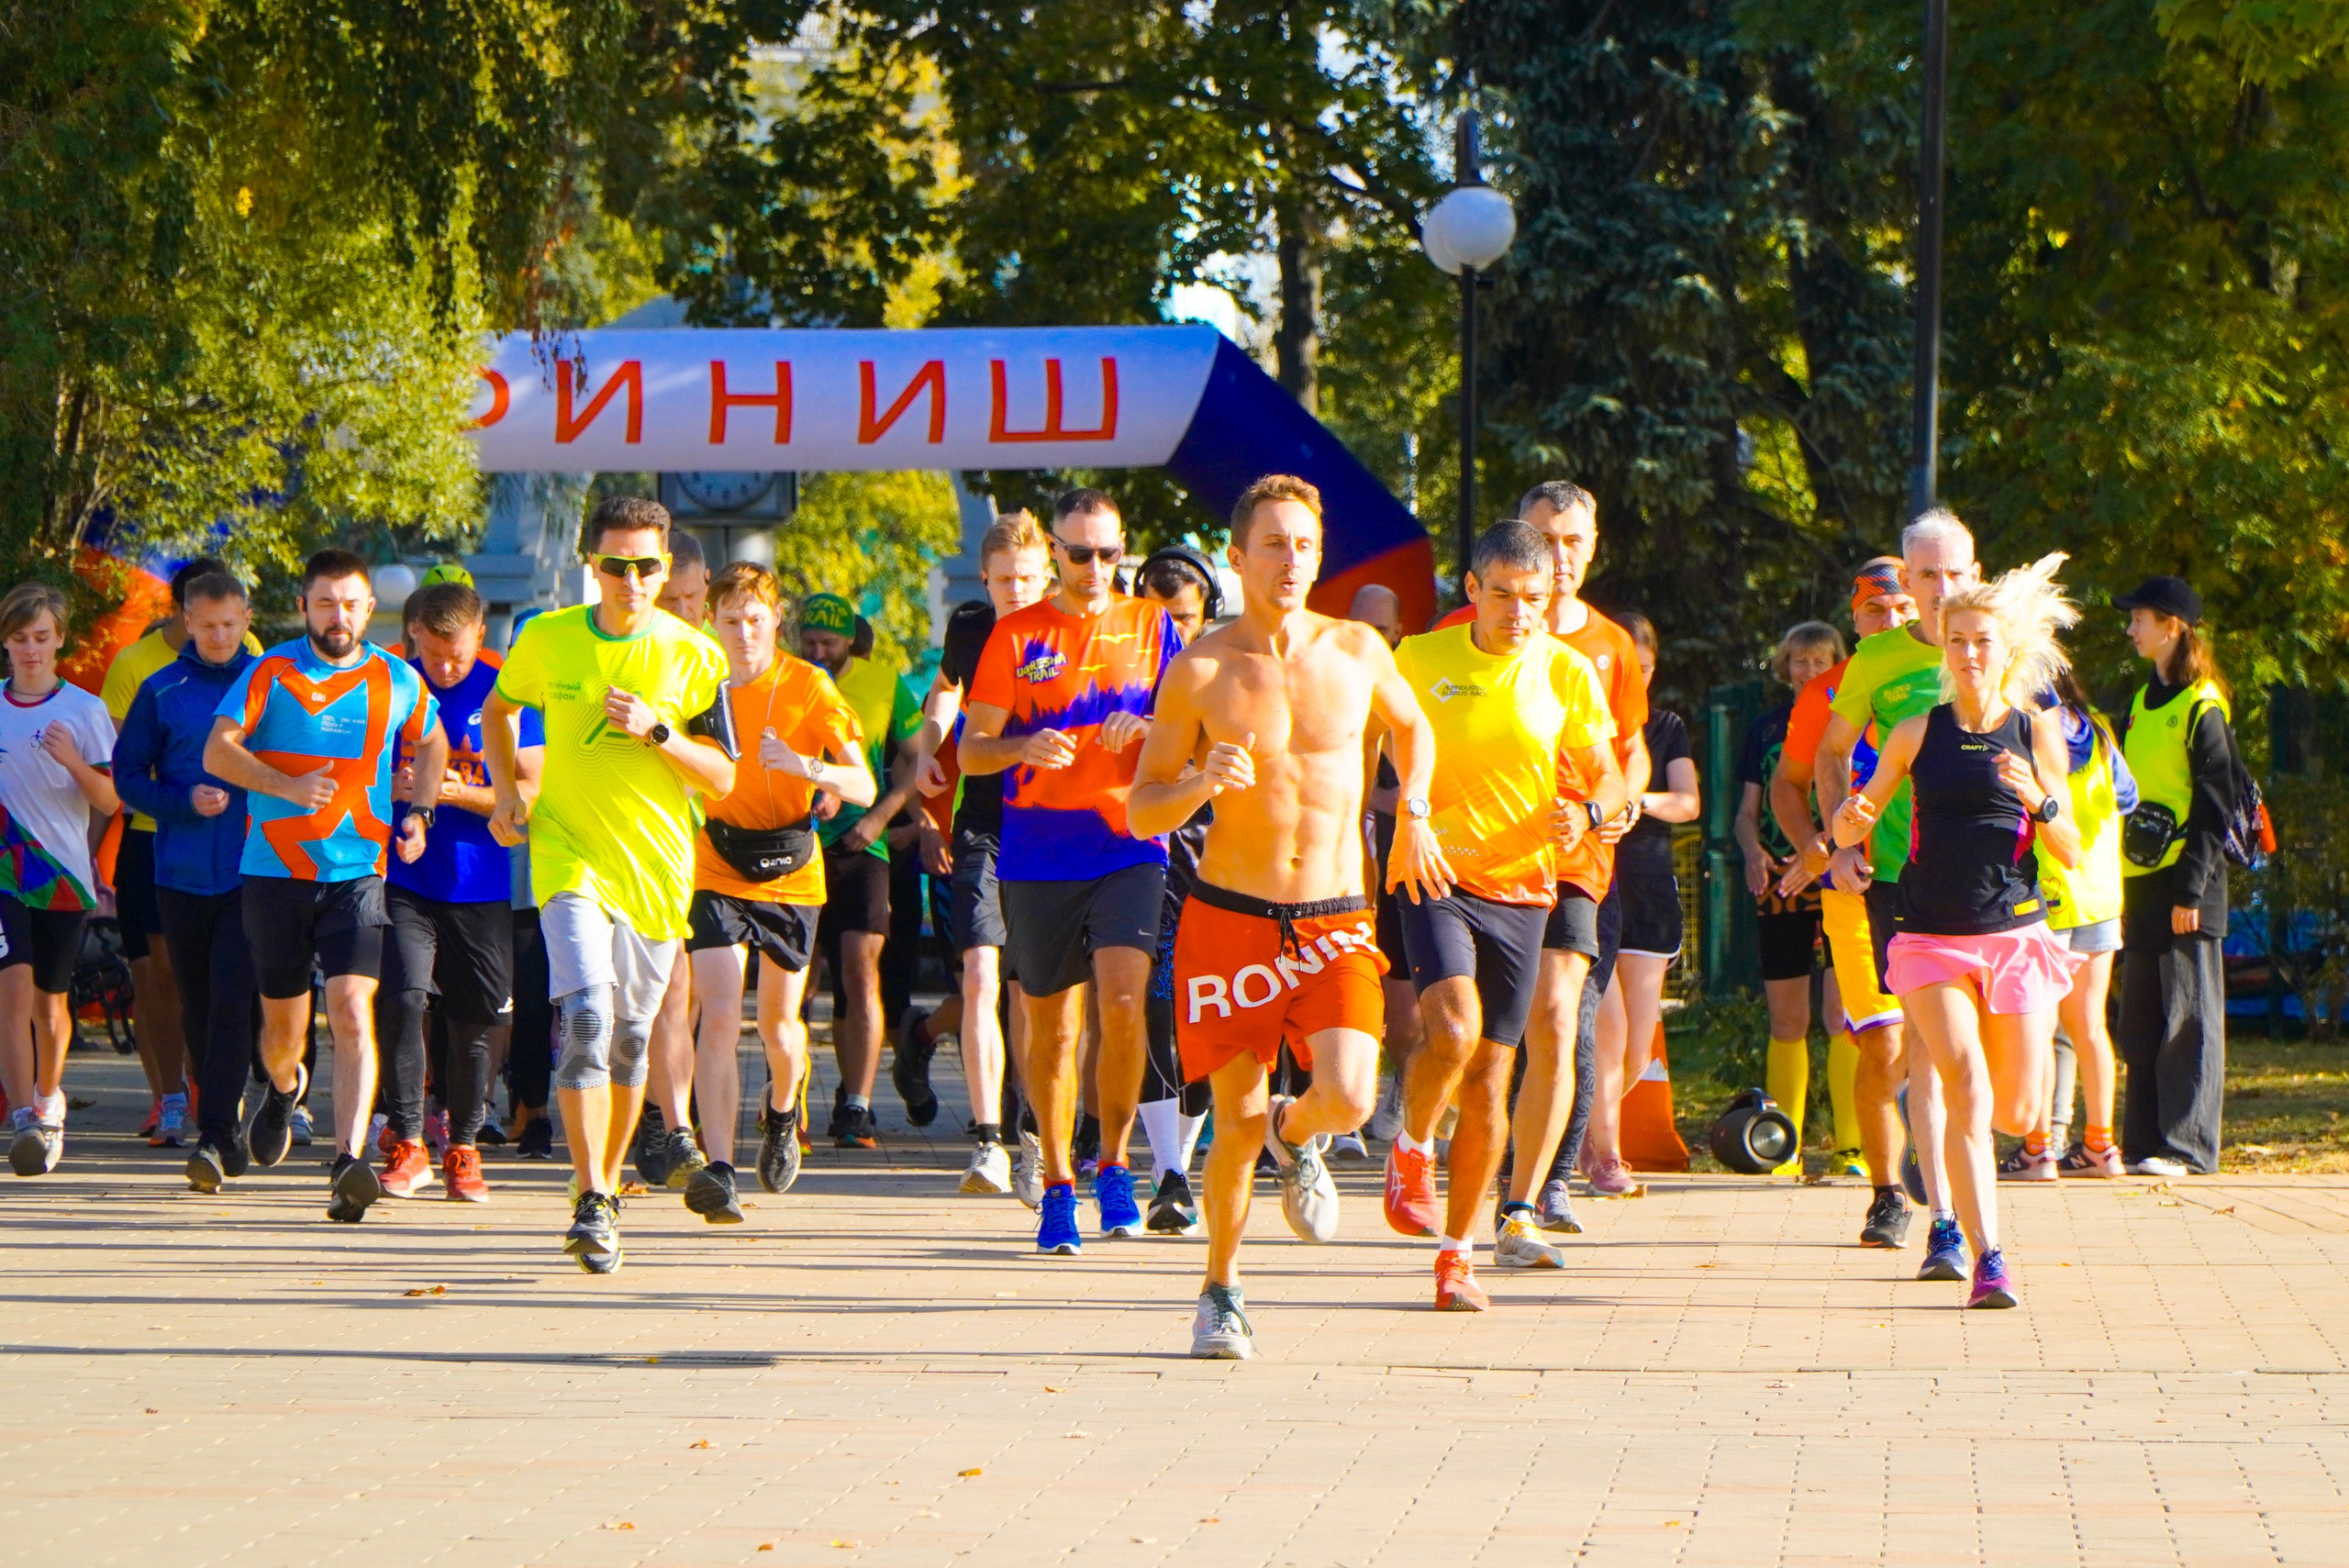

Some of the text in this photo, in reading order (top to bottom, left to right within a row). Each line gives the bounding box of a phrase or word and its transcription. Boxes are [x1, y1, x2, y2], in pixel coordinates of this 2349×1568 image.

[1016, 652, 1067, 677] UGRESHA
[1028, 667, 1061, 684] TRAIL
[1888, 692, 1909, 704] TRAIL
